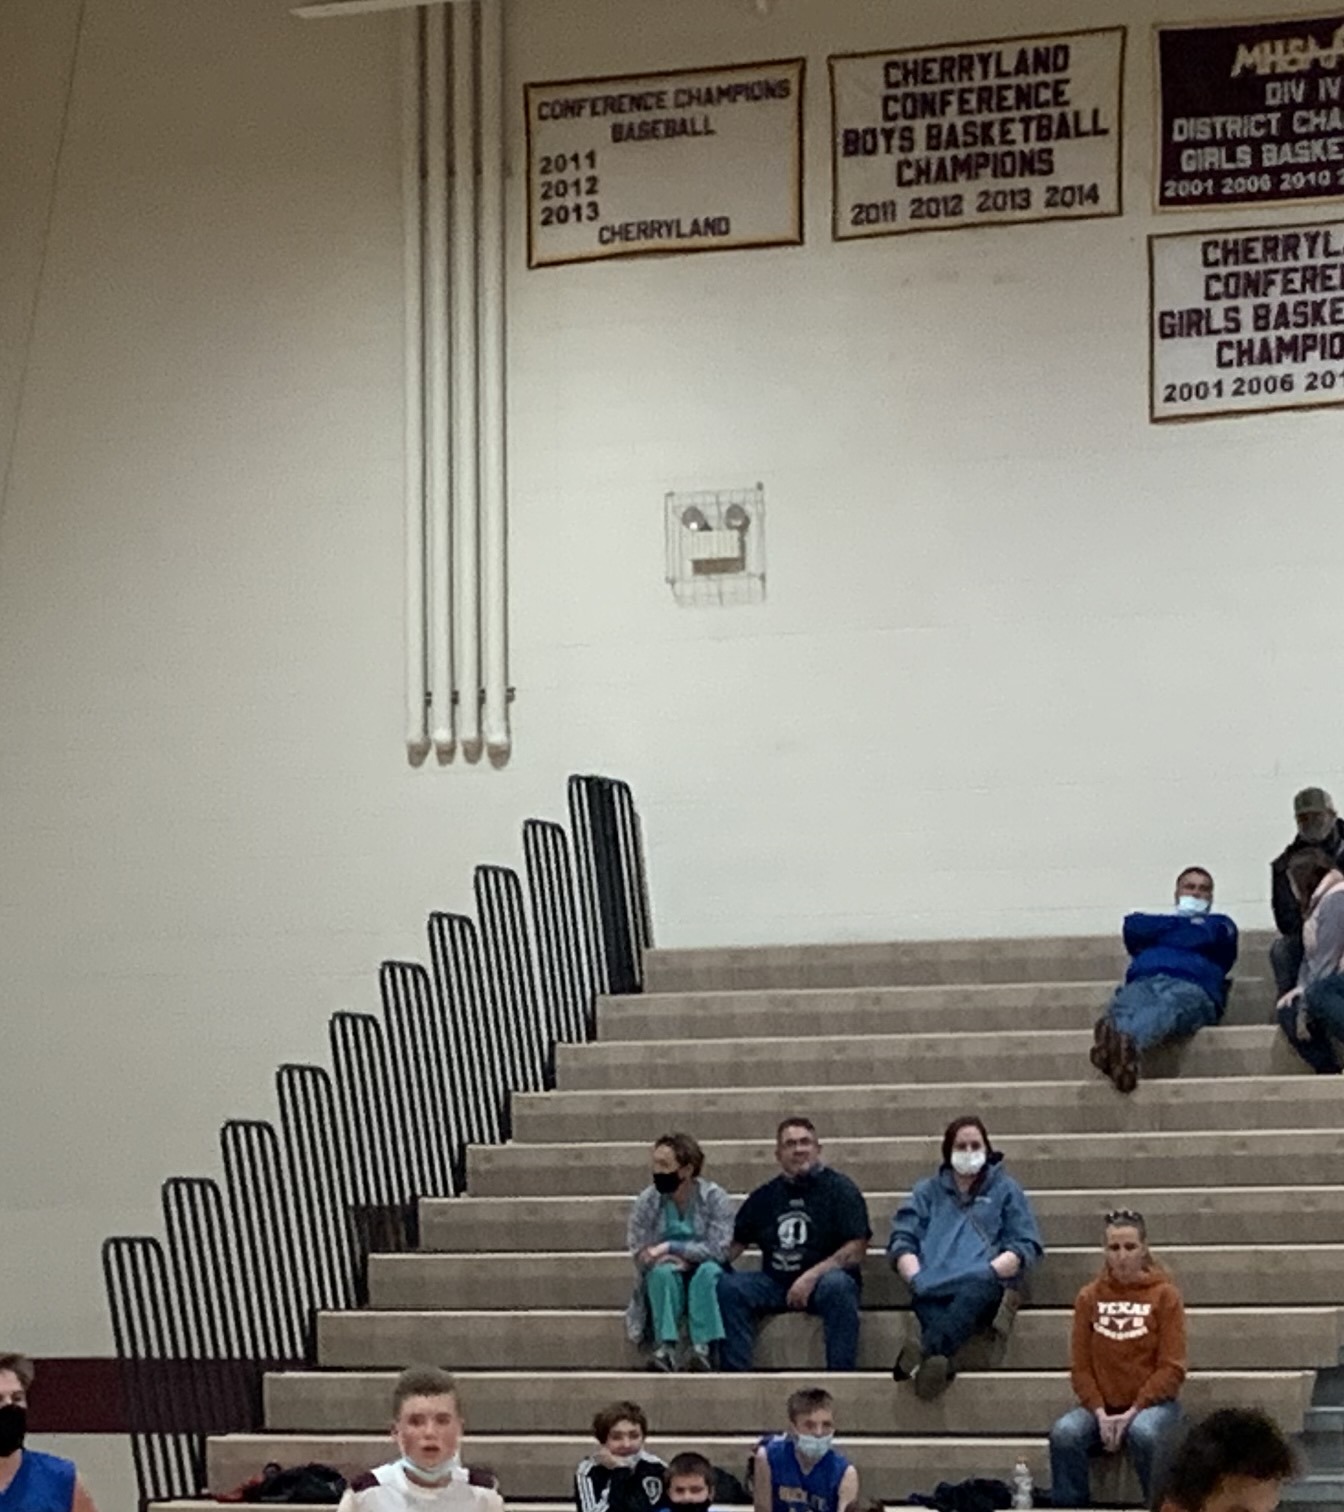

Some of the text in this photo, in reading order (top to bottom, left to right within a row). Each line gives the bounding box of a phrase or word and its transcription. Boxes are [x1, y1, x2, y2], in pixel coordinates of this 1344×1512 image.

[883, 44, 1070, 89] CHERRYLAND
[537, 79, 791, 120] CONFERENCE CHAMPIONS
[882, 79, 1070, 122] CONFERENCE
[1318, 76, 1341, 100] IV
[611, 116, 716, 143] BASEBALL
[842, 108, 1109, 158] BOYS BASKETBALL
[1172, 112, 1282, 142] DISTRICT
[539, 150, 596, 175] 2011
[896, 148, 1054, 187] CHAMPIONS
[1180, 146, 1252, 172] GIRLS
[540, 176, 599, 200] 2012
[1164, 180, 1214, 198] 2001
[1222, 174, 1271, 194] 2006
[1280, 170, 1330, 190] 2010
[540, 202, 600, 226] 2013
[851, 183, 1100, 226] 2011 2012 2013 2014
[598, 216, 731, 245] CHERRYLAND
[1158, 306, 1241, 339] GIRLS
[1163, 380, 1224, 403] 2001
[1231, 374, 1294, 397] 2006
[1097, 1301, 1152, 1316] TEXAS
